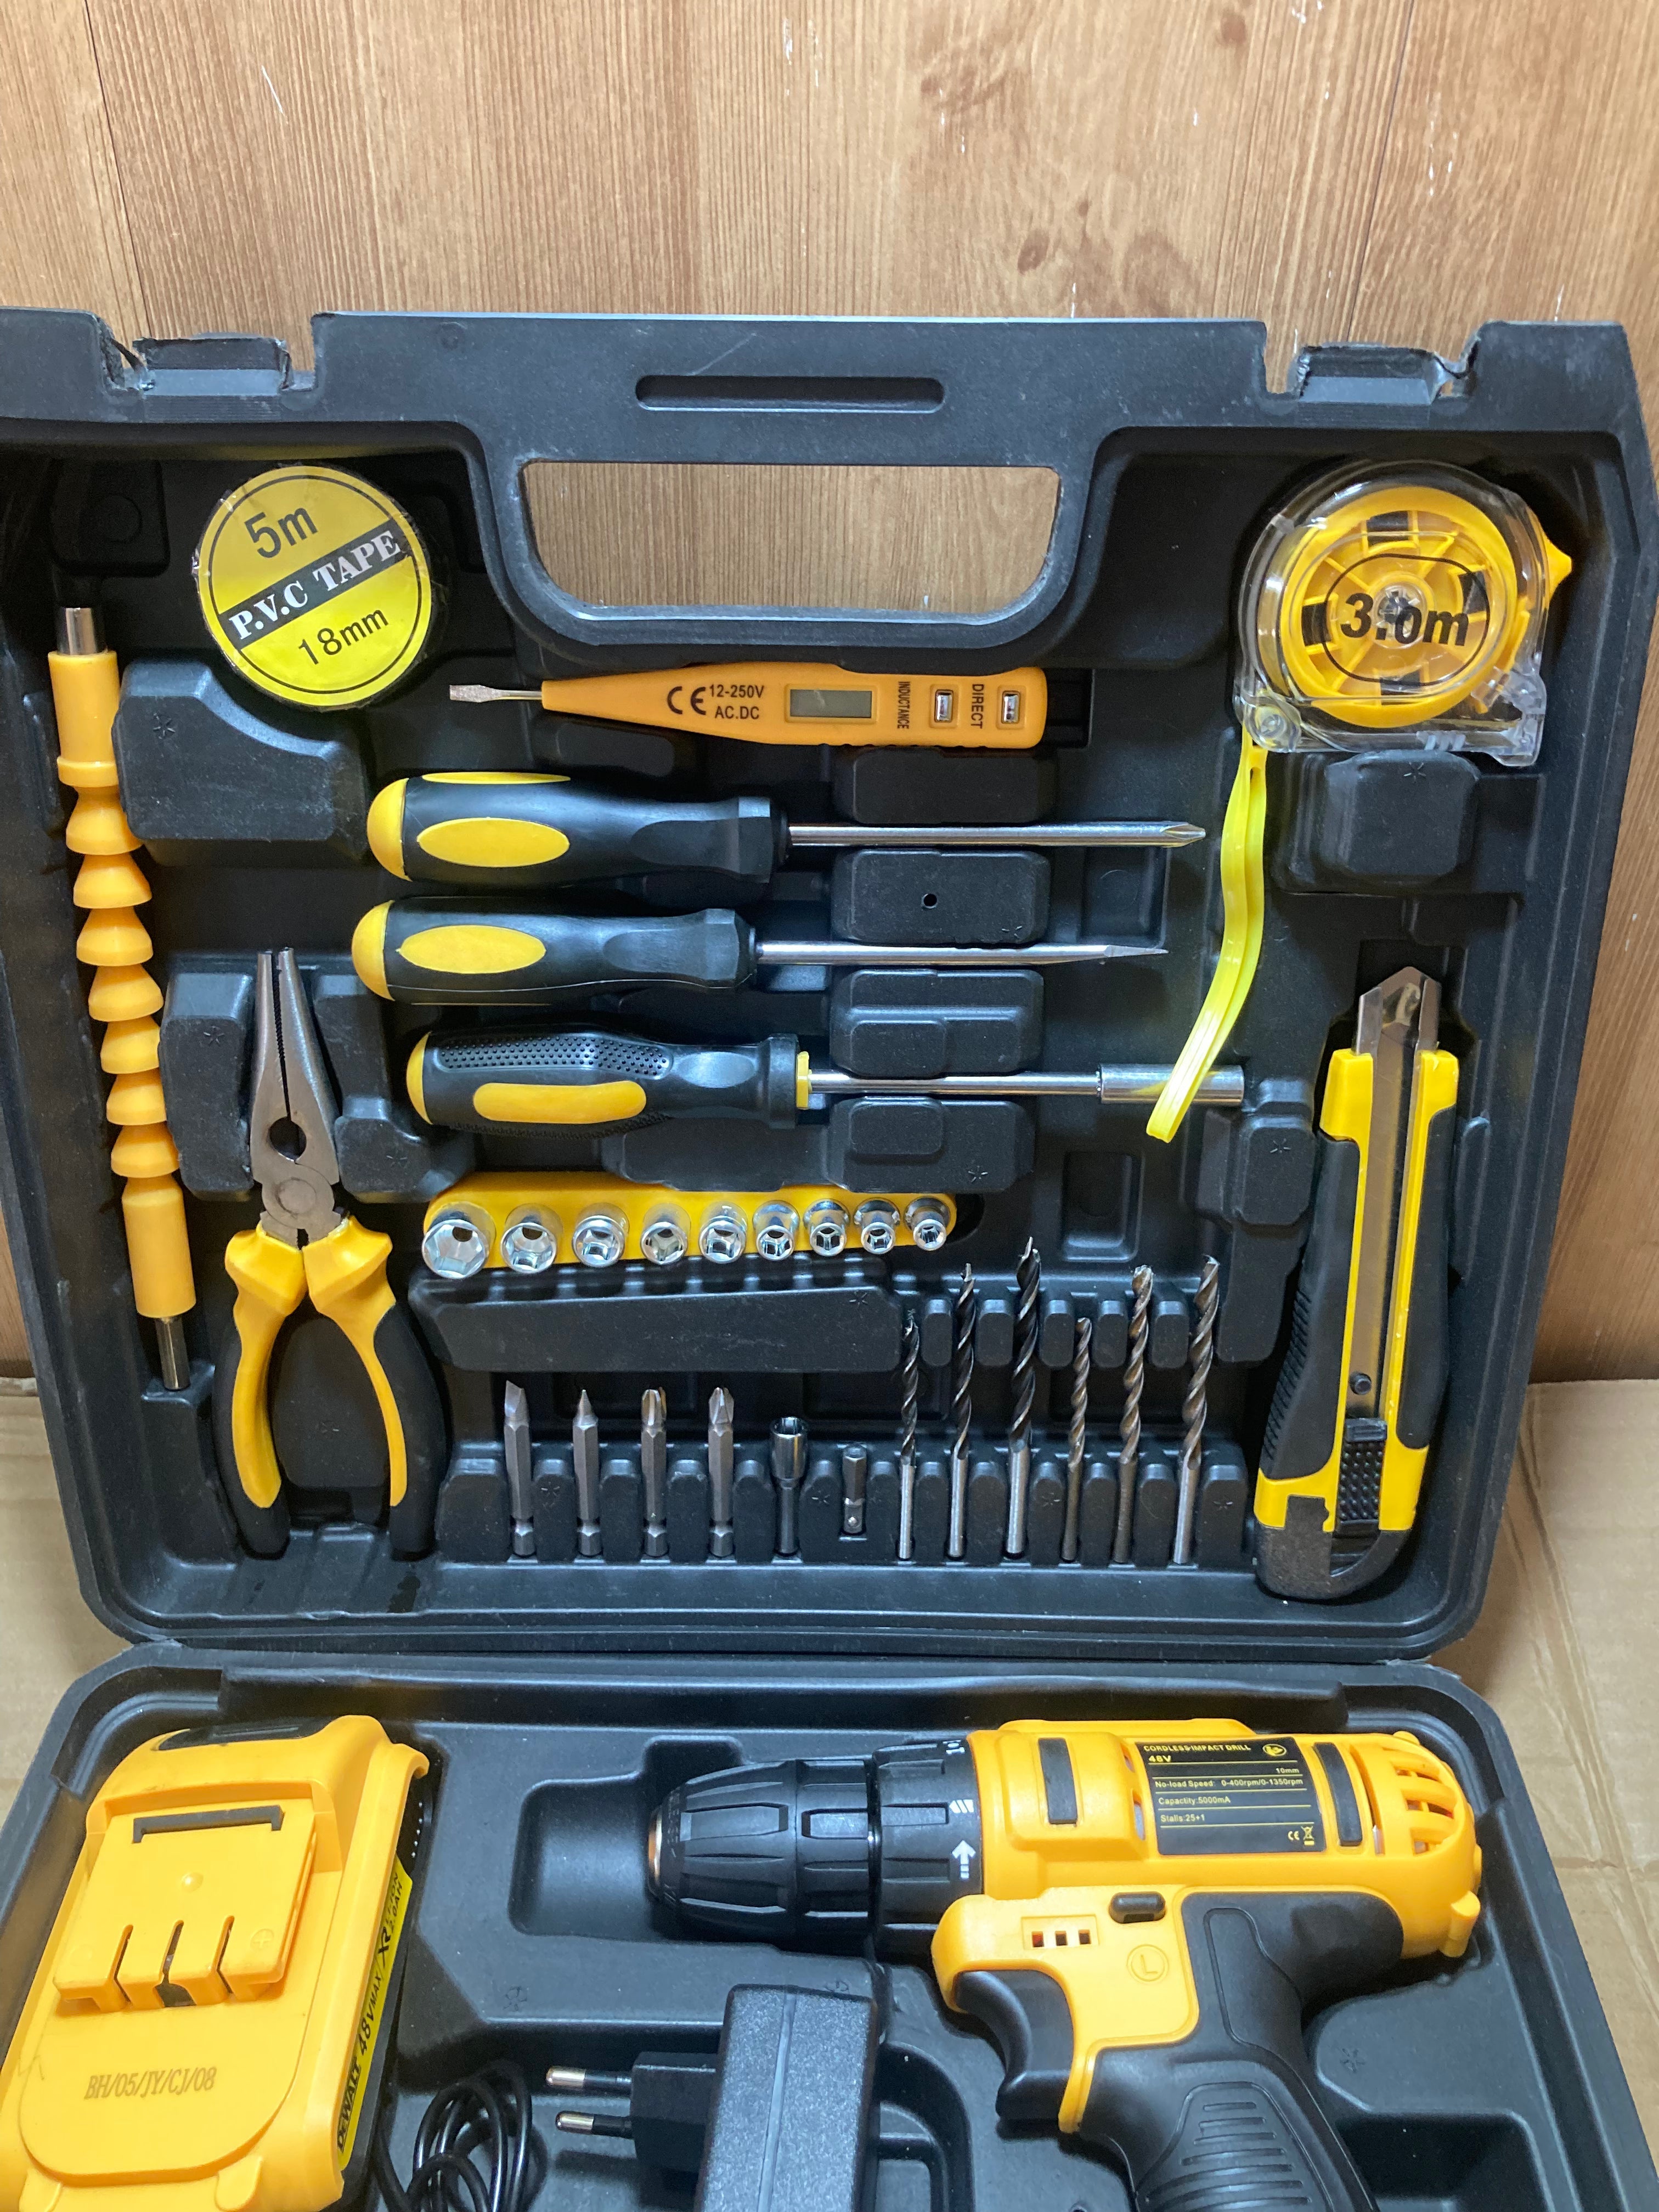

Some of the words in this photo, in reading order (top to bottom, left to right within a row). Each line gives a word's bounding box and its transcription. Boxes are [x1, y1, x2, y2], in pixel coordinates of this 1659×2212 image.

[244, 507, 318, 558] 5m
[228, 580, 308, 640] P.V.C
[313, 530, 401, 591] TAPE
[298, 609, 389, 665] 18mm
[1340, 592, 1470, 646] 3.0m
[709, 684, 765, 698] 12-250V
[714, 706, 760, 720] AC.DC
[897, 681, 910, 729] INDUCTANCE
[970, 684, 985, 729] DIRECT
